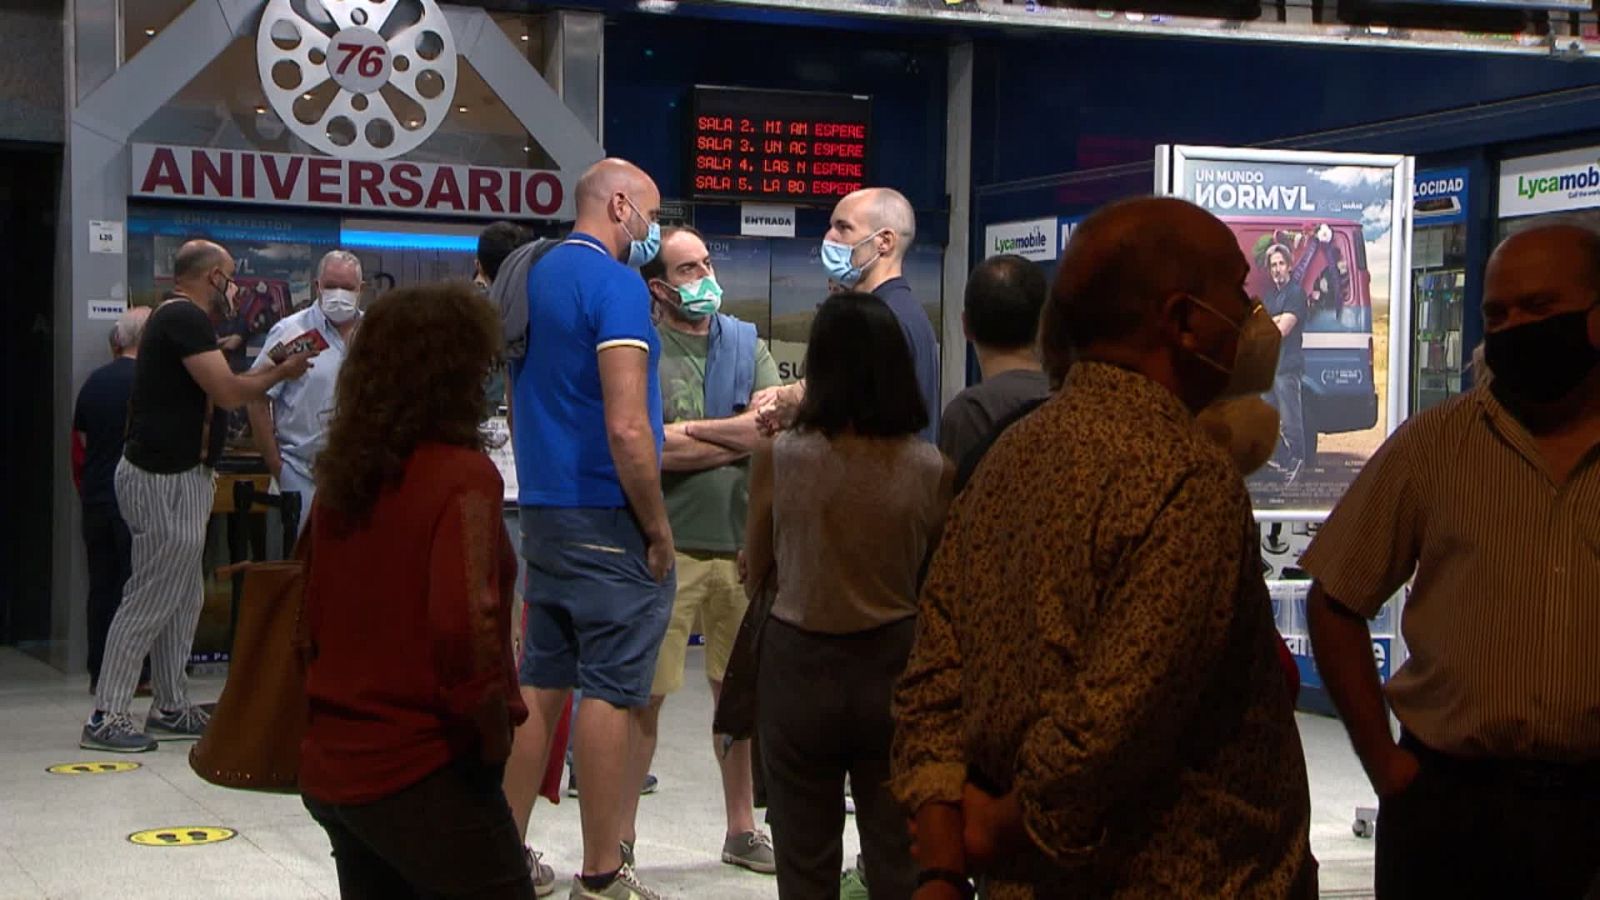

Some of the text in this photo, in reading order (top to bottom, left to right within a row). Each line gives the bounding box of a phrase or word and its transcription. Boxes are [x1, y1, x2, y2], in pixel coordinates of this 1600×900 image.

[336, 42, 386, 77] 76
[698, 117, 864, 138] SALA 2. MI AM ESPERE
[697, 136, 864, 158] SALA 3. UN AC ESPERE
[696, 156, 862, 177] SALA 4. LAS N ESPERE
[1195, 169, 1264, 183] UN MUNDO
[140, 147, 563, 216] ANIVERSARIO
[695, 175, 730, 190] SALA
[738, 178, 753, 191] 5.
[763, 179, 780, 192] LA
[788, 180, 805, 193] BO
[744, 215, 792, 226] ENTRADA
[994, 231, 1047, 253] Lycamobile
